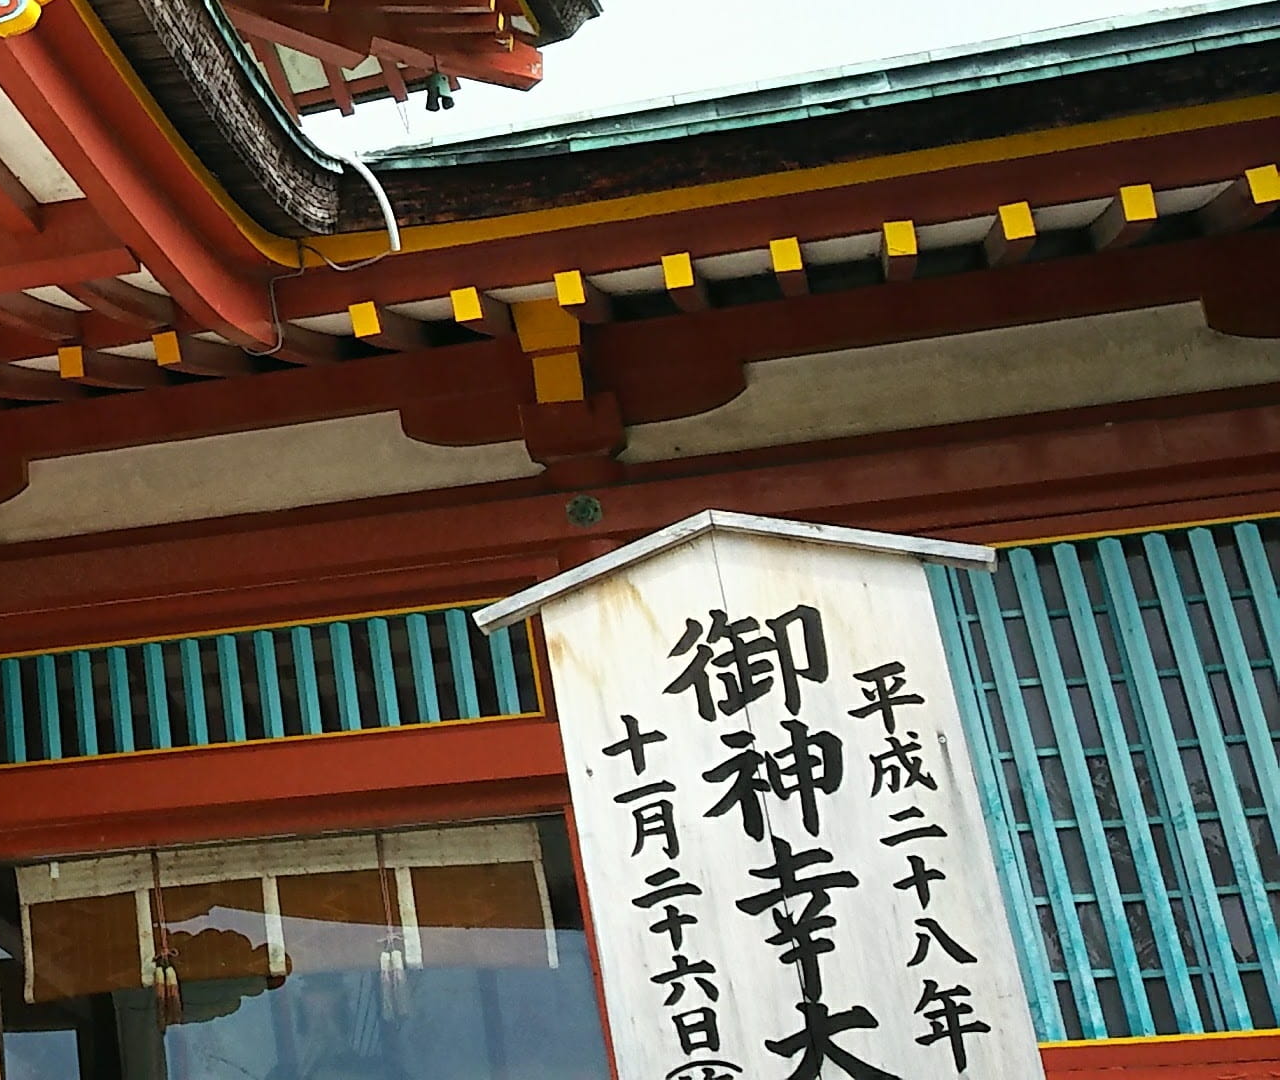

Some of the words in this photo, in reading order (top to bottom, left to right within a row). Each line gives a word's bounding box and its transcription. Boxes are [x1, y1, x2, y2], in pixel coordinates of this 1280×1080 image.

[602, 715, 743, 1080] 十一月二十六日(
[848, 661, 991, 1073] 平成二十八年
